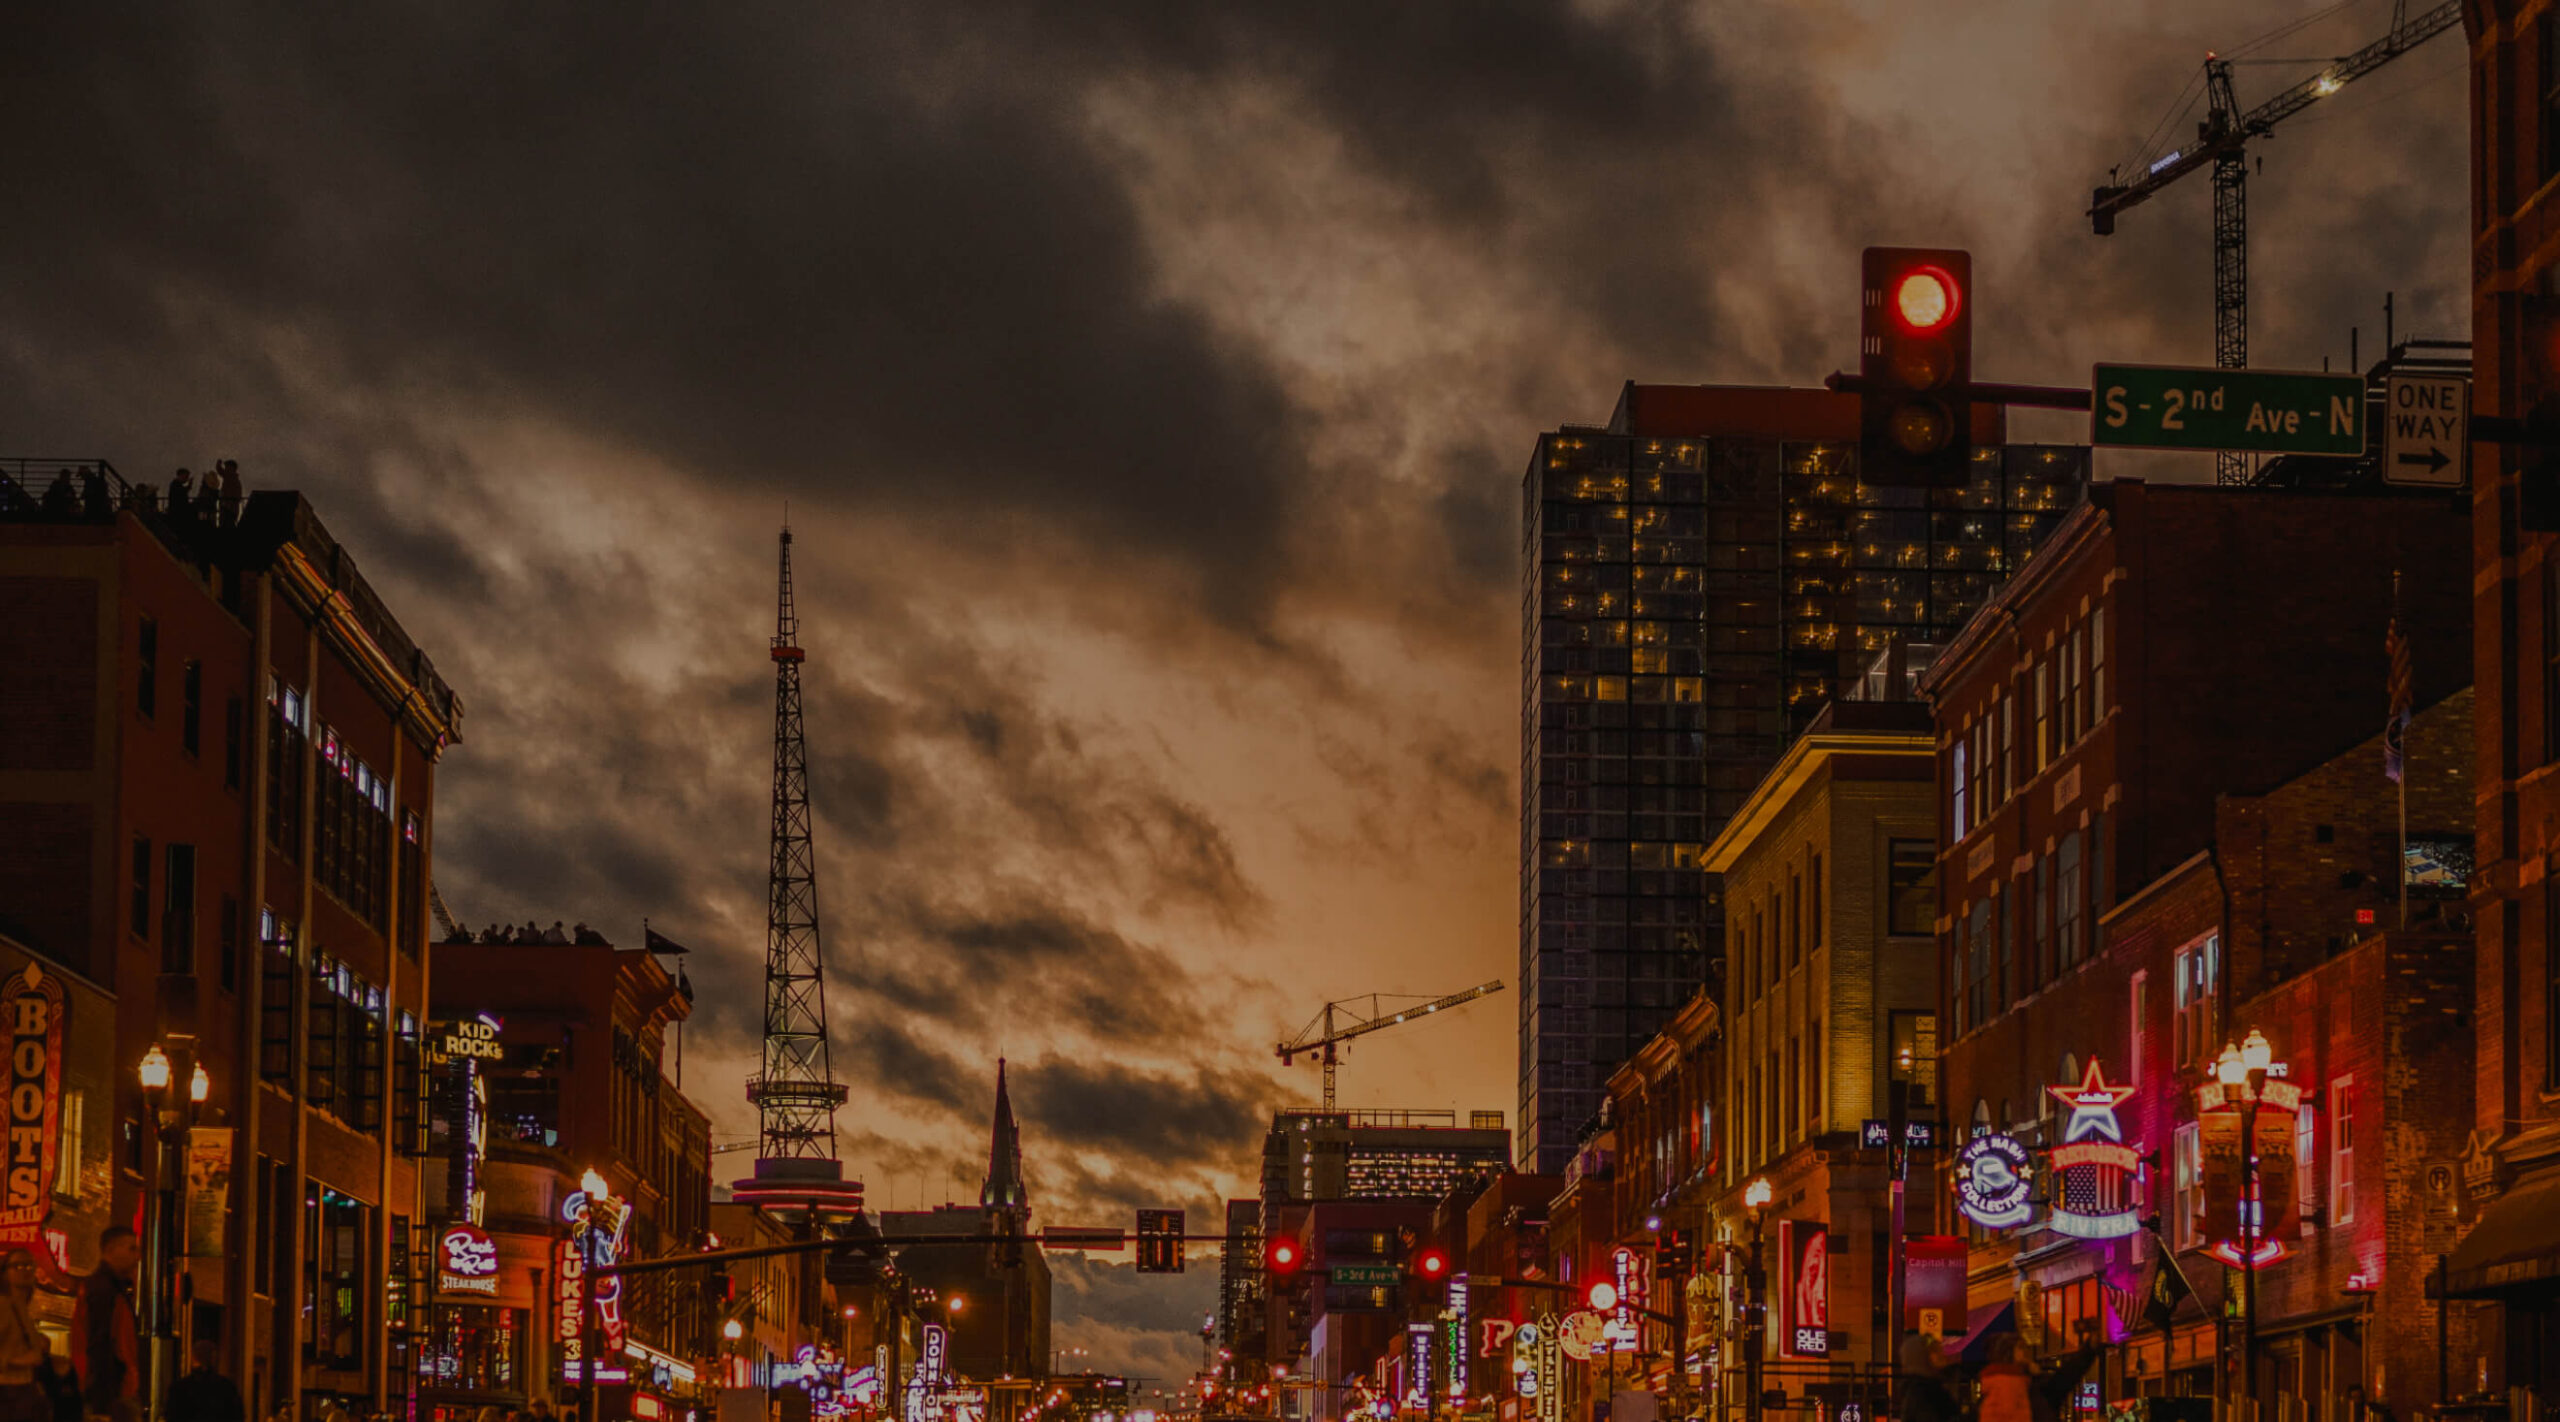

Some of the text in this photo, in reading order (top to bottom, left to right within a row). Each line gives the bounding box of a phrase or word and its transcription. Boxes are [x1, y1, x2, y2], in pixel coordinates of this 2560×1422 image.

[2399, 384, 2456, 411] ONE
[2396, 415, 2456, 440] WAY
[459, 1021, 493, 1040] KID
[8, 997, 48, 1209] BOOTS
[1965, 1139, 1989, 1160] THE
[1960, 1181, 2030, 1213] COLLECTION
[2053, 1207, 2139, 1238] RIVIERA
[442, 1275, 497, 1294] STEAKHOUSE
[1796, 1329, 1827, 1341] OLE
[1796, 1340, 1827, 1352] RED
[924, 1332, 941, 1422] DOWNTOW
